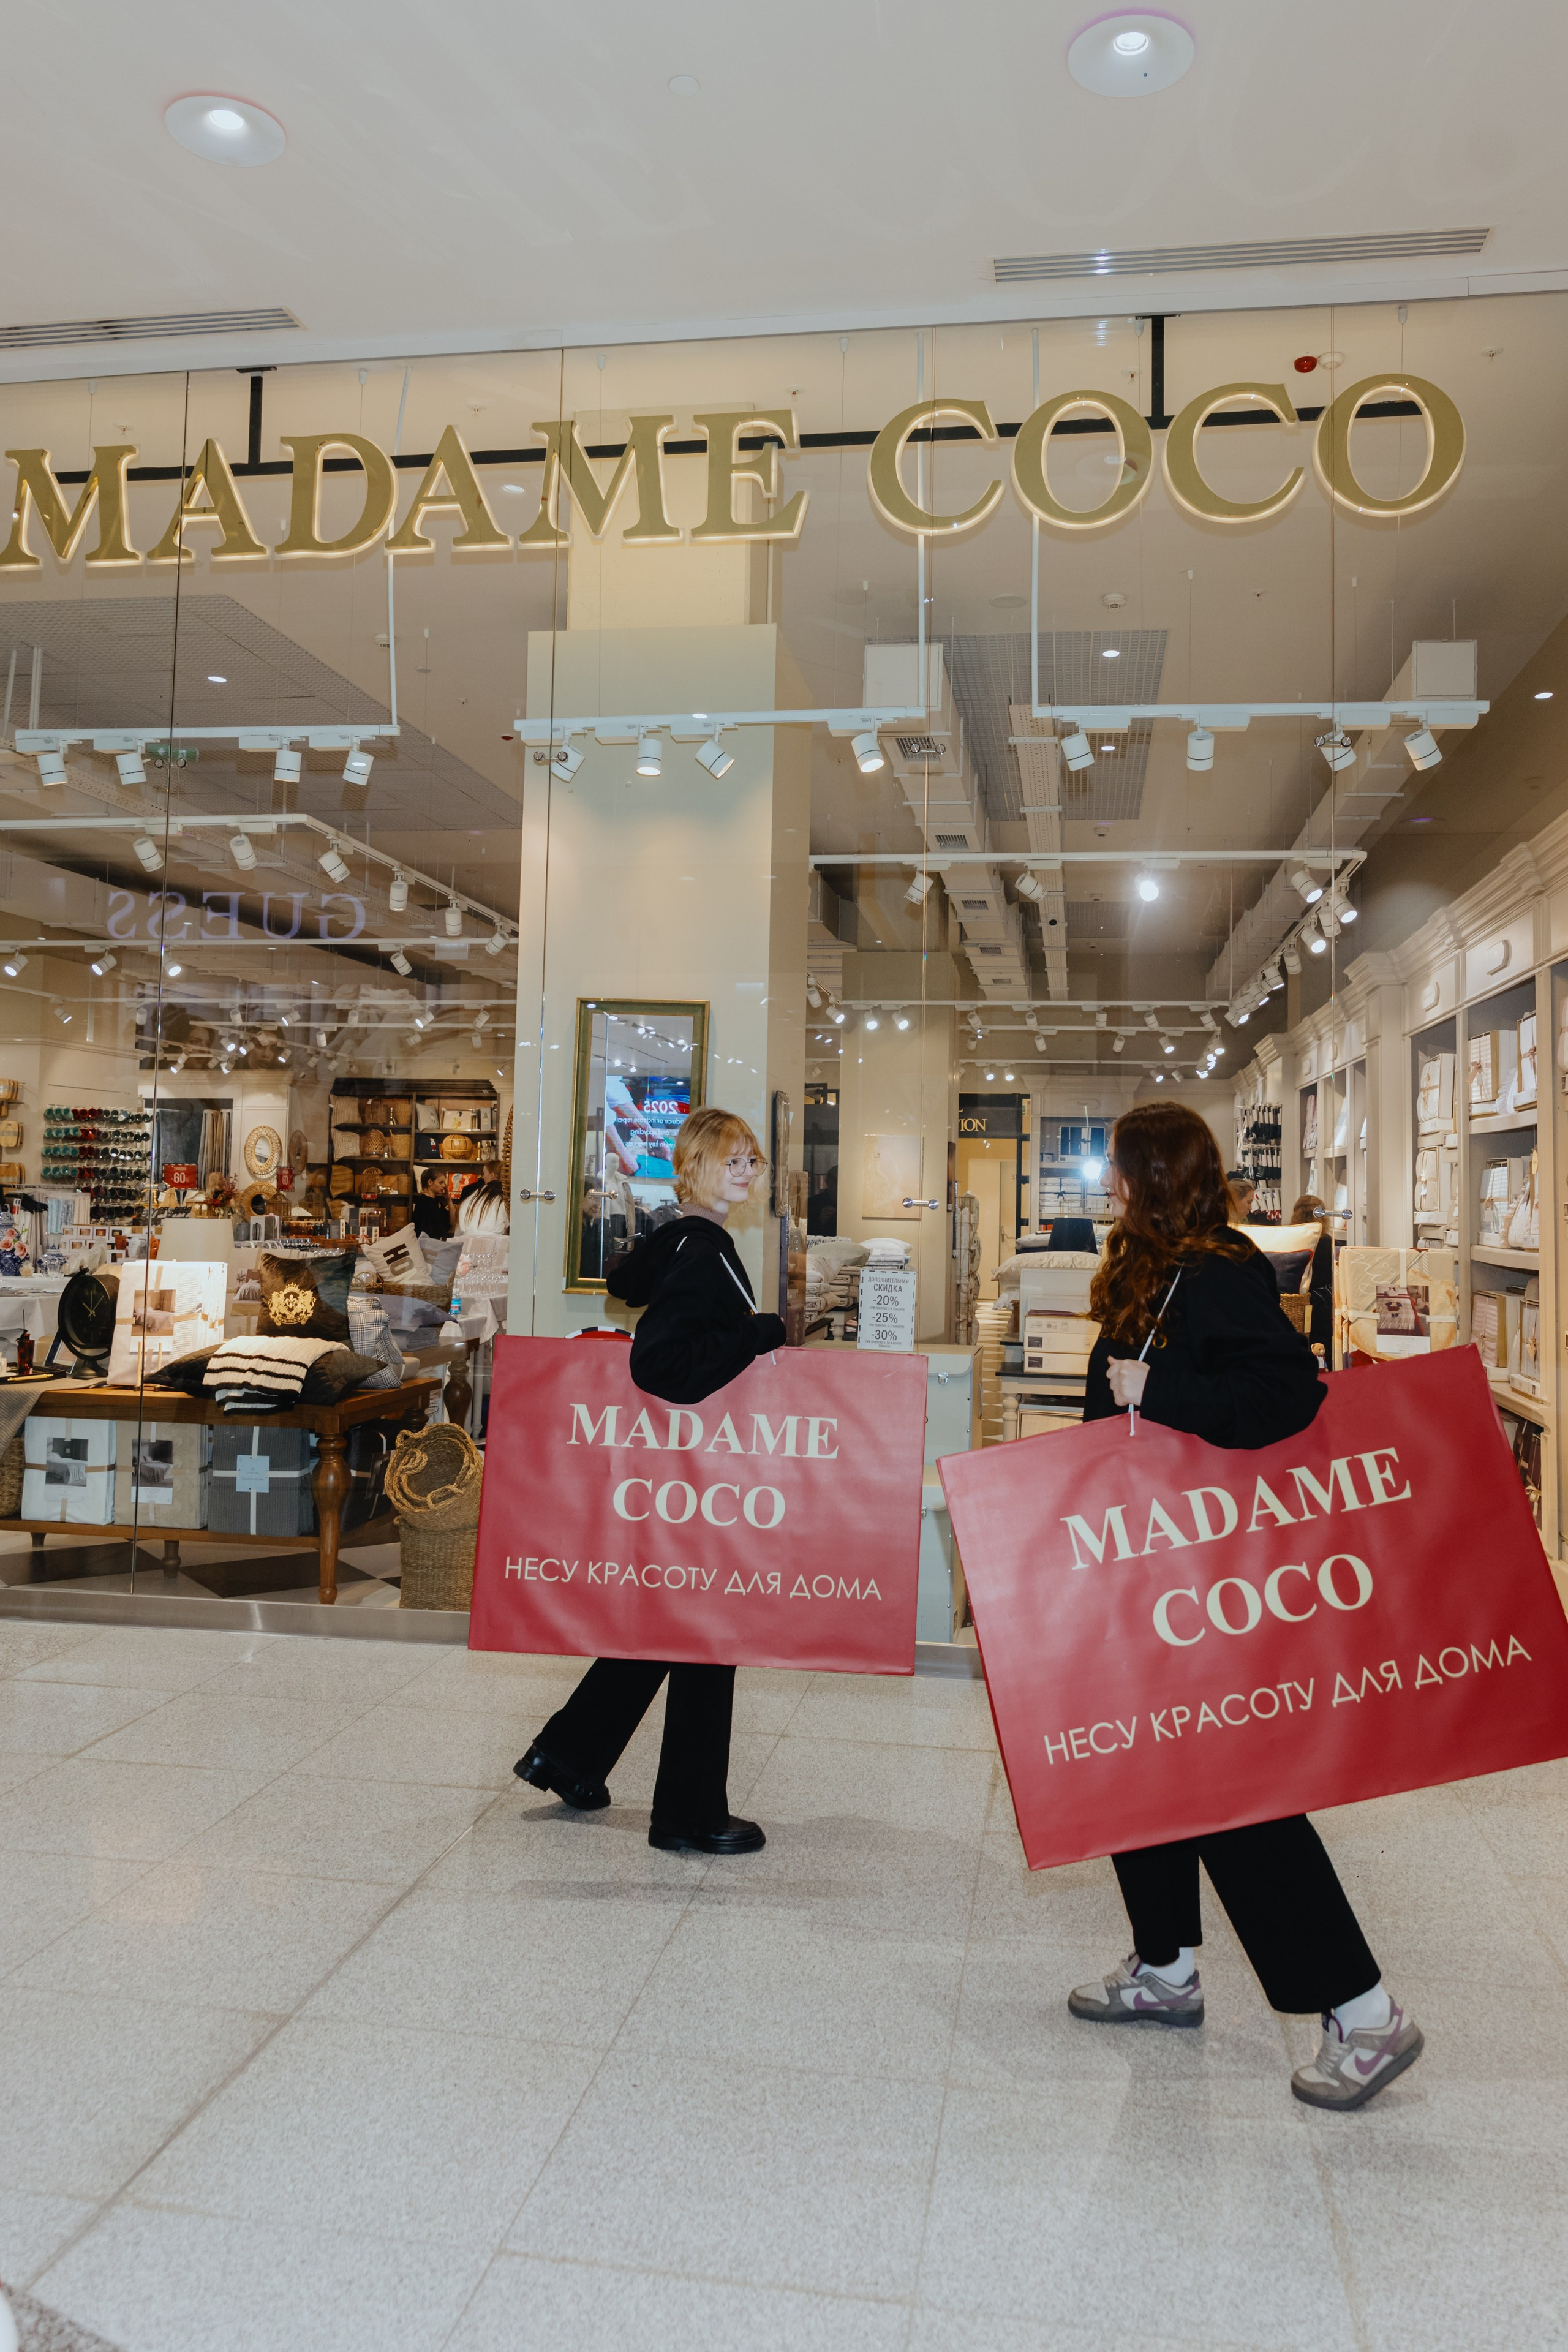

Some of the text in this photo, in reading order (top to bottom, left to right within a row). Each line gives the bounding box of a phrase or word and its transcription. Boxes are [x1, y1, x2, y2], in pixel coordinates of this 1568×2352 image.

[0, 373, 1468, 570] MADAME COCO
[958, 1118, 987, 1131] ION
[873, 1283, 902, 1293] СКИДКА
[873, 1295, 899, 1306] -20%
[871, 1329, 897, 1341] -30%
[872, 1312, 898, 1324] -25%
[567, 1403, 839, 1459] MADAME
[612, 1478, 786, 1528] COCO
[1060, 1446, 1412, 1570] MADAME
[505, 1556, 882, 1601] НЕСУ КРАСОТУ ДЛЯ ДОМА
[1153, 1553, 1373, 1647] COCO
[1044, 1634, 1532, 1765] НЕСУ КРАСОТУ ДЛЯ ДОМА
